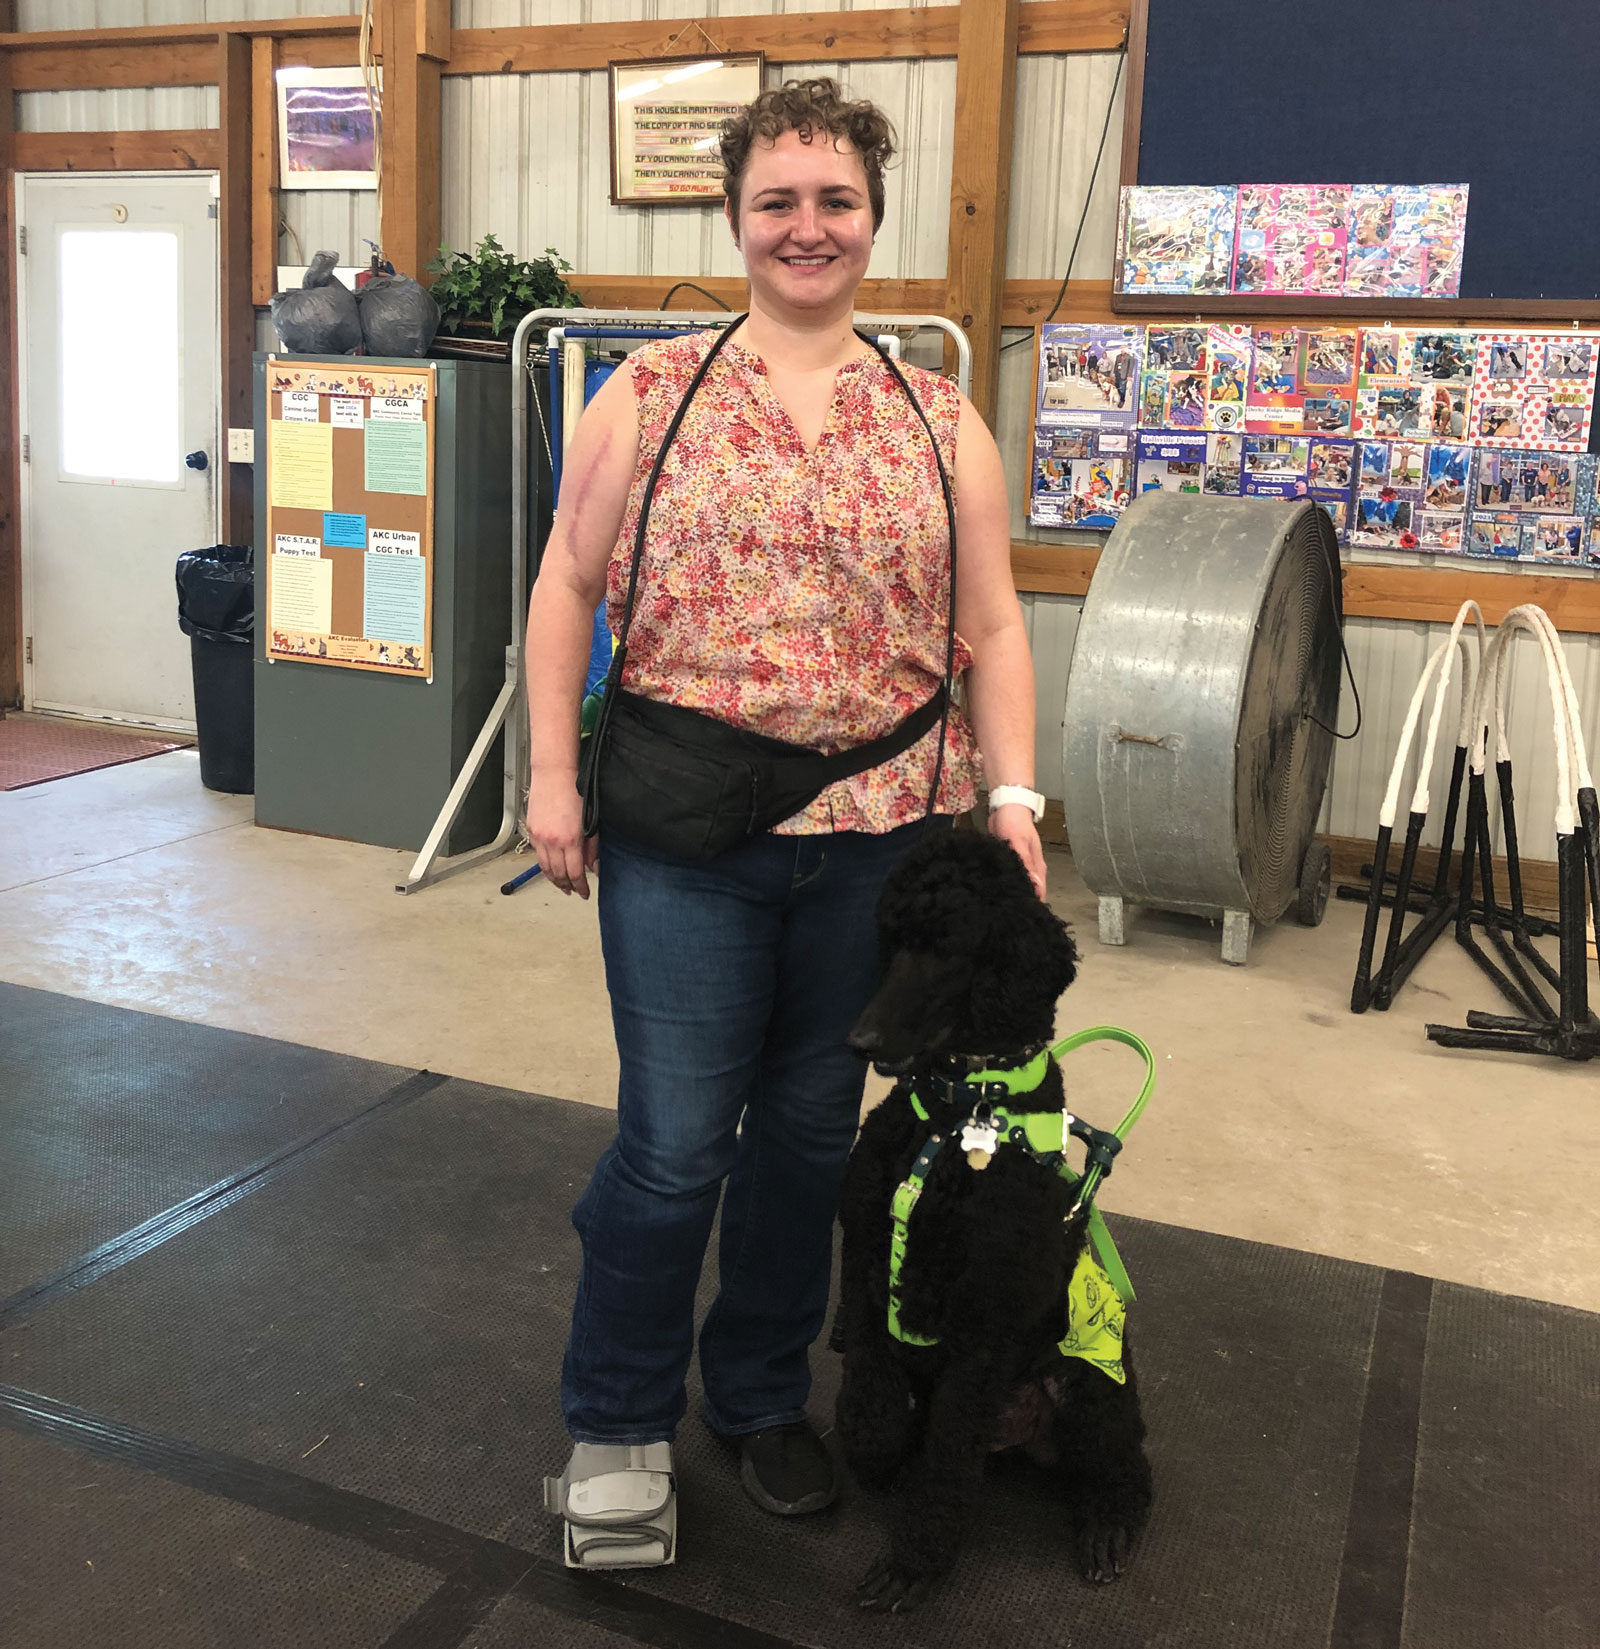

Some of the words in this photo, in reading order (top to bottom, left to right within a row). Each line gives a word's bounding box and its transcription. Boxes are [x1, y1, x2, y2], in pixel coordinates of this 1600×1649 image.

[634, 106, 653, 114] THIS
[655, 106, 679, 114] HOUSE
[680, 106, 689, 114] IS
[689, 106, 738, 114] MAINTAINED
[635, 121, 651, 130] THE
[651, 121, 688, 130] COMFORT
[689, 121, 706, 130] AND
[670, 136, 679, 144] OF
[680, 136, 693, 144] MY
[635, 155, 646, 163] IF
[647, 155, 663, 163] YOU
[663, 155, 697, 163] CANNOT
[697, 155, 722, 164] ACCEP
[635, 169, 656, 178] THEN
[657, 169, 673, 178] YOU
[673, 169, 706, 178] CANNOT
[669, 184, 679, 192] SO
[680, 184, 691, 192] GO
[691, 184, 715, 193] AWAY
[291, 393, 309, 402] CGC
[385, 398, 409, 408] CGCA
[284, 405, 302, 413] Canine
[303, 406, 318, 414] Good
[284, 415, 303, 423] Citizen
[1142, 436, 1176, 444] Hallsville
[1176, 437, 1206, 446] Primary
[277, 535, 291, 543] AKC
[293, 536, 319, 546] S.T.A.R.
[373, 531, 390, 539] AKC
[392, 532, 416, 542] Urban
[279, 547, 300, 557] Puppy
[301, 549, 316, 557] Test
[375, 545, 393, 554] CGC
[395, 547, 413, 556] Test
